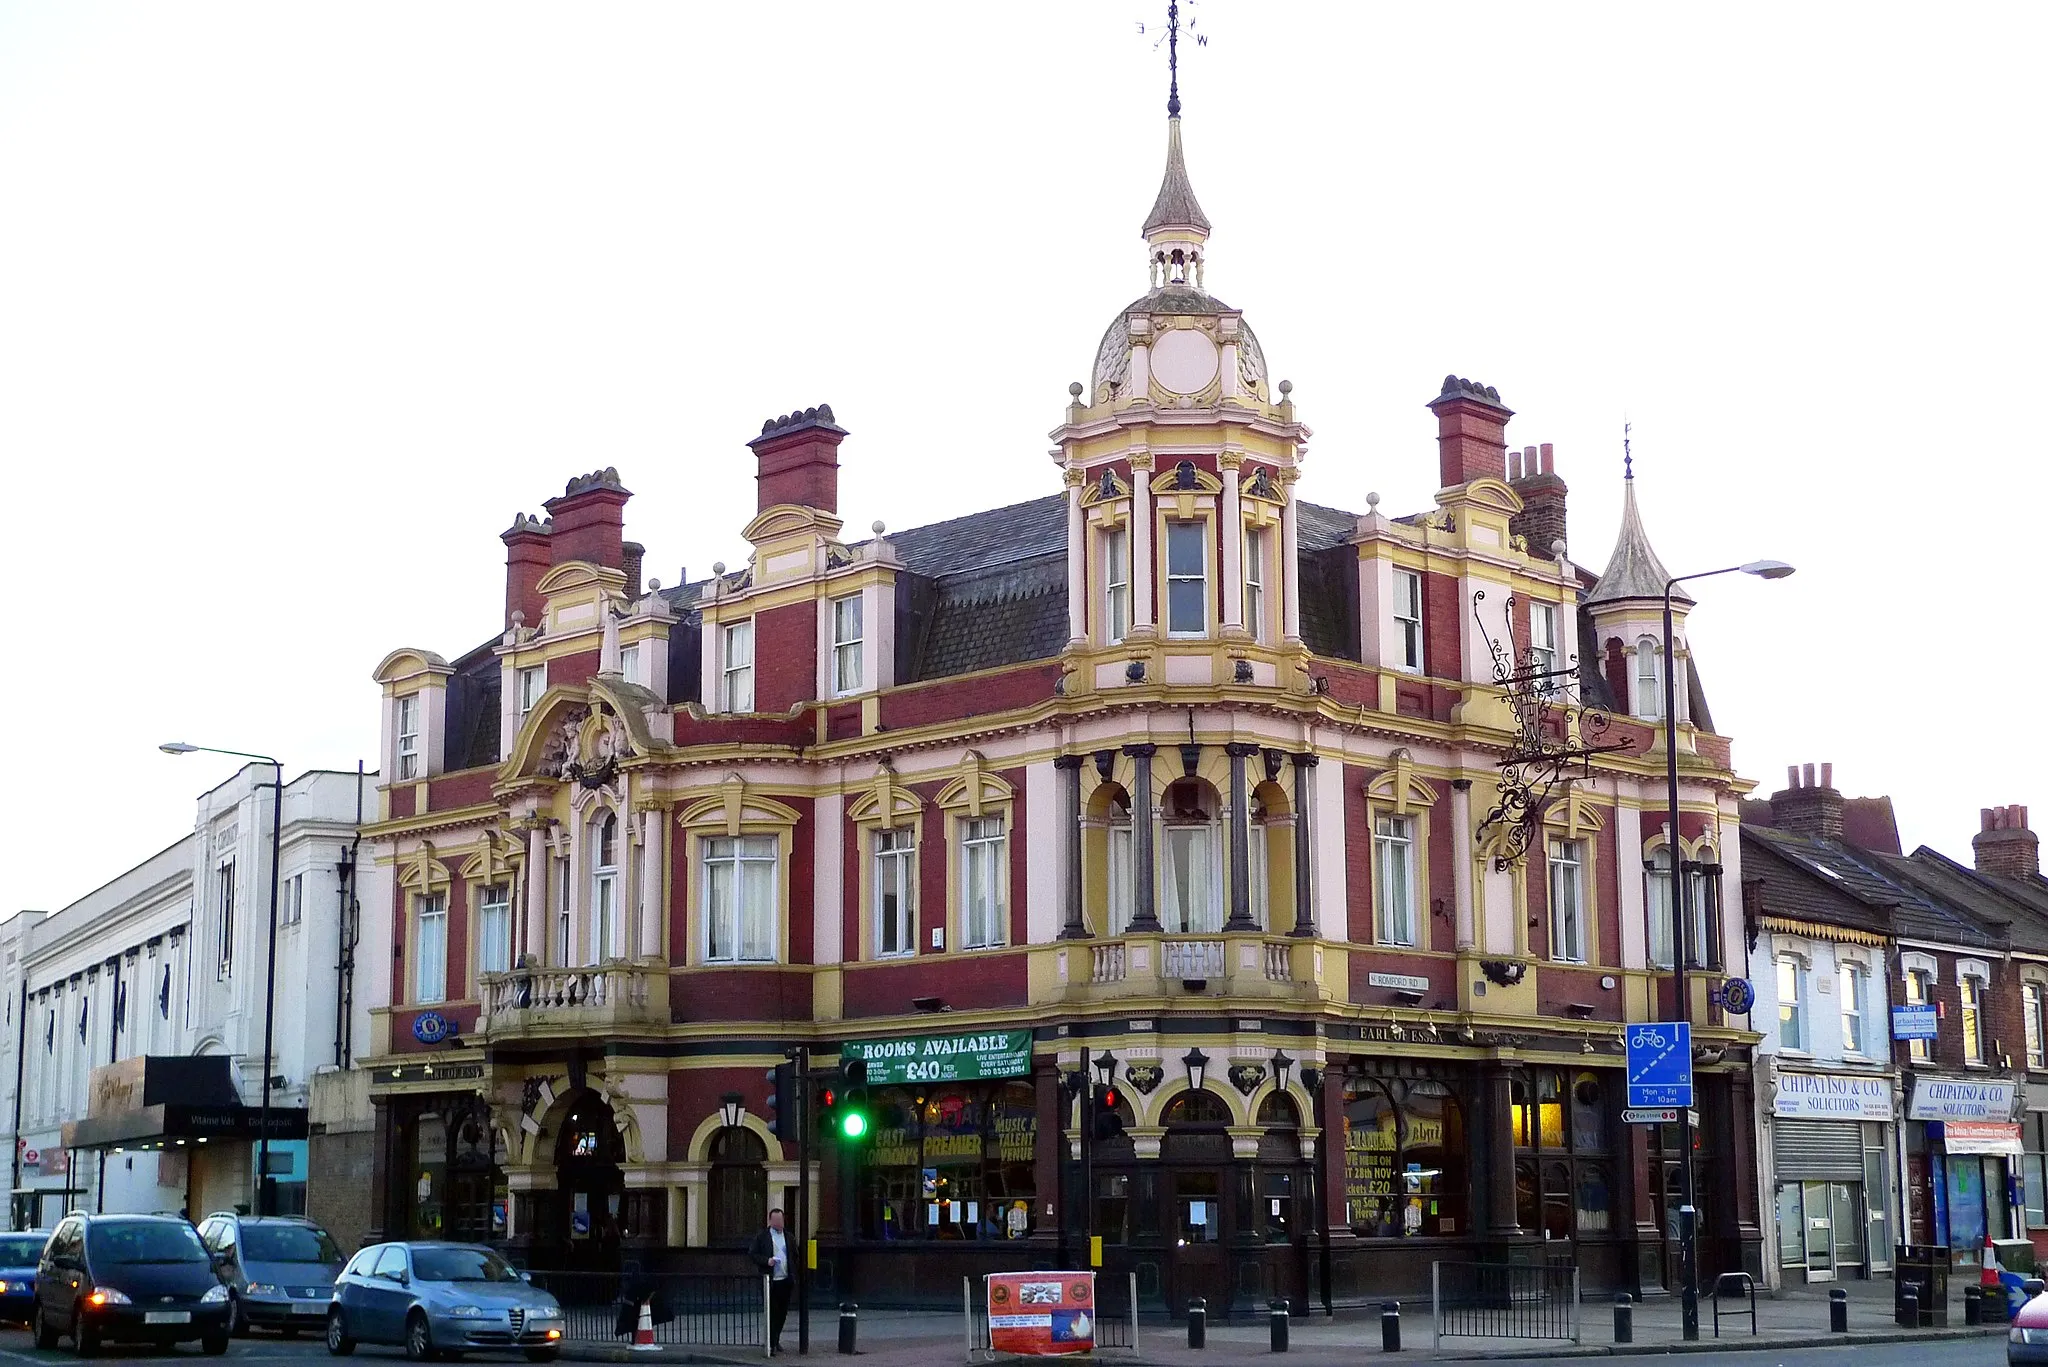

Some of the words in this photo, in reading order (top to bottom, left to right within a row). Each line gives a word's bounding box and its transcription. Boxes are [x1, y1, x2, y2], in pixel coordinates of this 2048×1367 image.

[1378, 976, 1407, 986] ROMFORD
[1409, 978, 1418, 987] RD
[1360, 1027, 1390, 1041] EARL
[1394, 1029, 1408, 1042] OF
[1411, 1030, 1444, 1043] ESSEX
[863, 1041, 916, 1059] ROOMS
[923, 1034, 1009, 1056] AVAILABLE
[988, 1050, 1028, 1060] ENTERTAINMENT
[943, 1064, 955, 1072] PER
[997, 1058, 1024, 1066] SATURDAY
[906, 1060, 940, 1080] £40
[941, 1071, 958, 1079] NIGHT
[979, 1068, 991, 1076] 020
[1680, 1073, 1687, 1081] 12
[1781, 1075, 1847, 1095] CHIPATISO
[1851, 1079, 1860, 1096] &
[1863, 1080, 1883, 1097] CO.
[1929, 1083, 1977, 1100] CHIPATISO
[1979, 1087, 1986, 1101] &
[1989, 1087, 2003, 1102] CO.
[1807, 1097, 1860, 1111] SOLICITORS
[1942, 1102, 1986, 1116] SOLICITORS
[995, 1117, 1029, 1133] MUSIC
[1030, 1117, 1037, 1131] &
[876, 1129, 906, 1147] EAST
[998, 1132, 1035, 1148] TALENT
[923, 1134, 982, 1156] PREMIER
[1000, 1147, 1034, 1162] VENUE
[1359, 1156, 1378, 1166] HERE
[1379, 1156, 1391, 1166] ON
[1354, 1168, 1372, 1178] 28th
[1374, 1168, 1391, 1178] NOV
[1368, 1181, 1390, 1194] £20
[1351, 1199, 1361, 1208] on
[1363, 1197, 1379, 1208] Sale
[1355, 1208, 1374, 1219] Here
